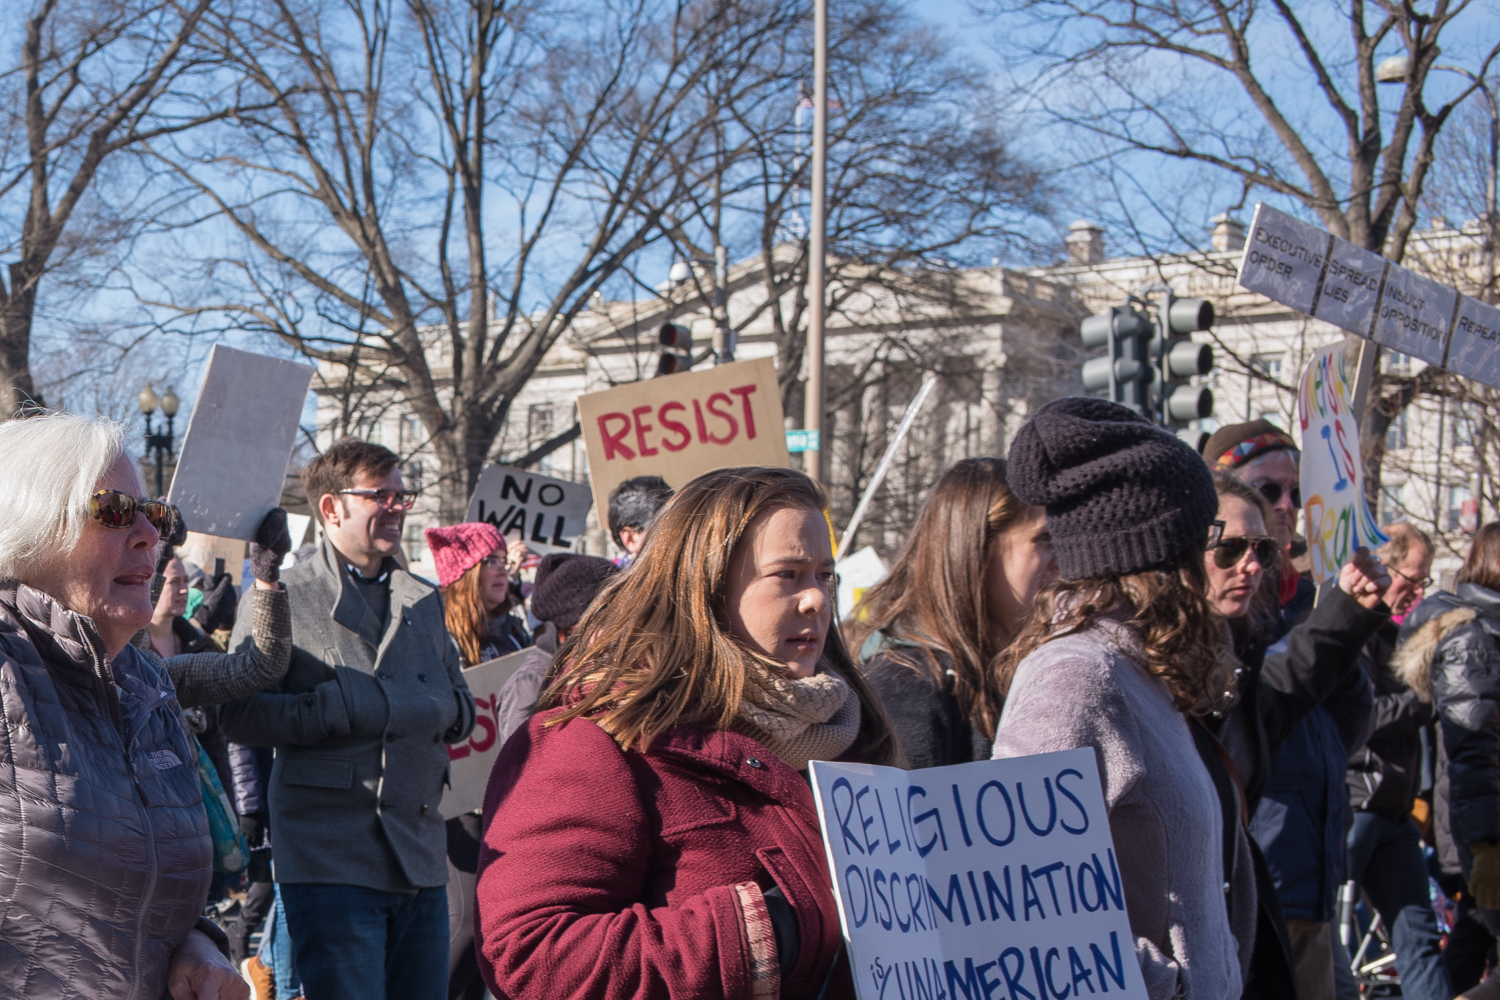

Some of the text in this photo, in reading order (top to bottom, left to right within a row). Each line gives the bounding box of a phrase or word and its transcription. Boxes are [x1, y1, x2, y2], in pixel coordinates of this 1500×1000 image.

[1249, 250, 1293, 279] ORDER
[1255, 227, 1323, 268] EXECUTIVE
[1323, 284, 1350, 303] LIES
[1329, 260, 1378, 291] SPREAD
[1384, 283, 1426, 310] INSULT
[1380, 305, 1448, 343] OPPOSITION
[597, 384, 757, 460] RESIST
[501, 474, 564, 506] NO
[479, 500, 571, 548] WALL
[831, 768, 1089, 858] RELIGIOUS
[844, 848, 1125, 933] DISCRIMINATION
[870, 956, 884, 990] is
